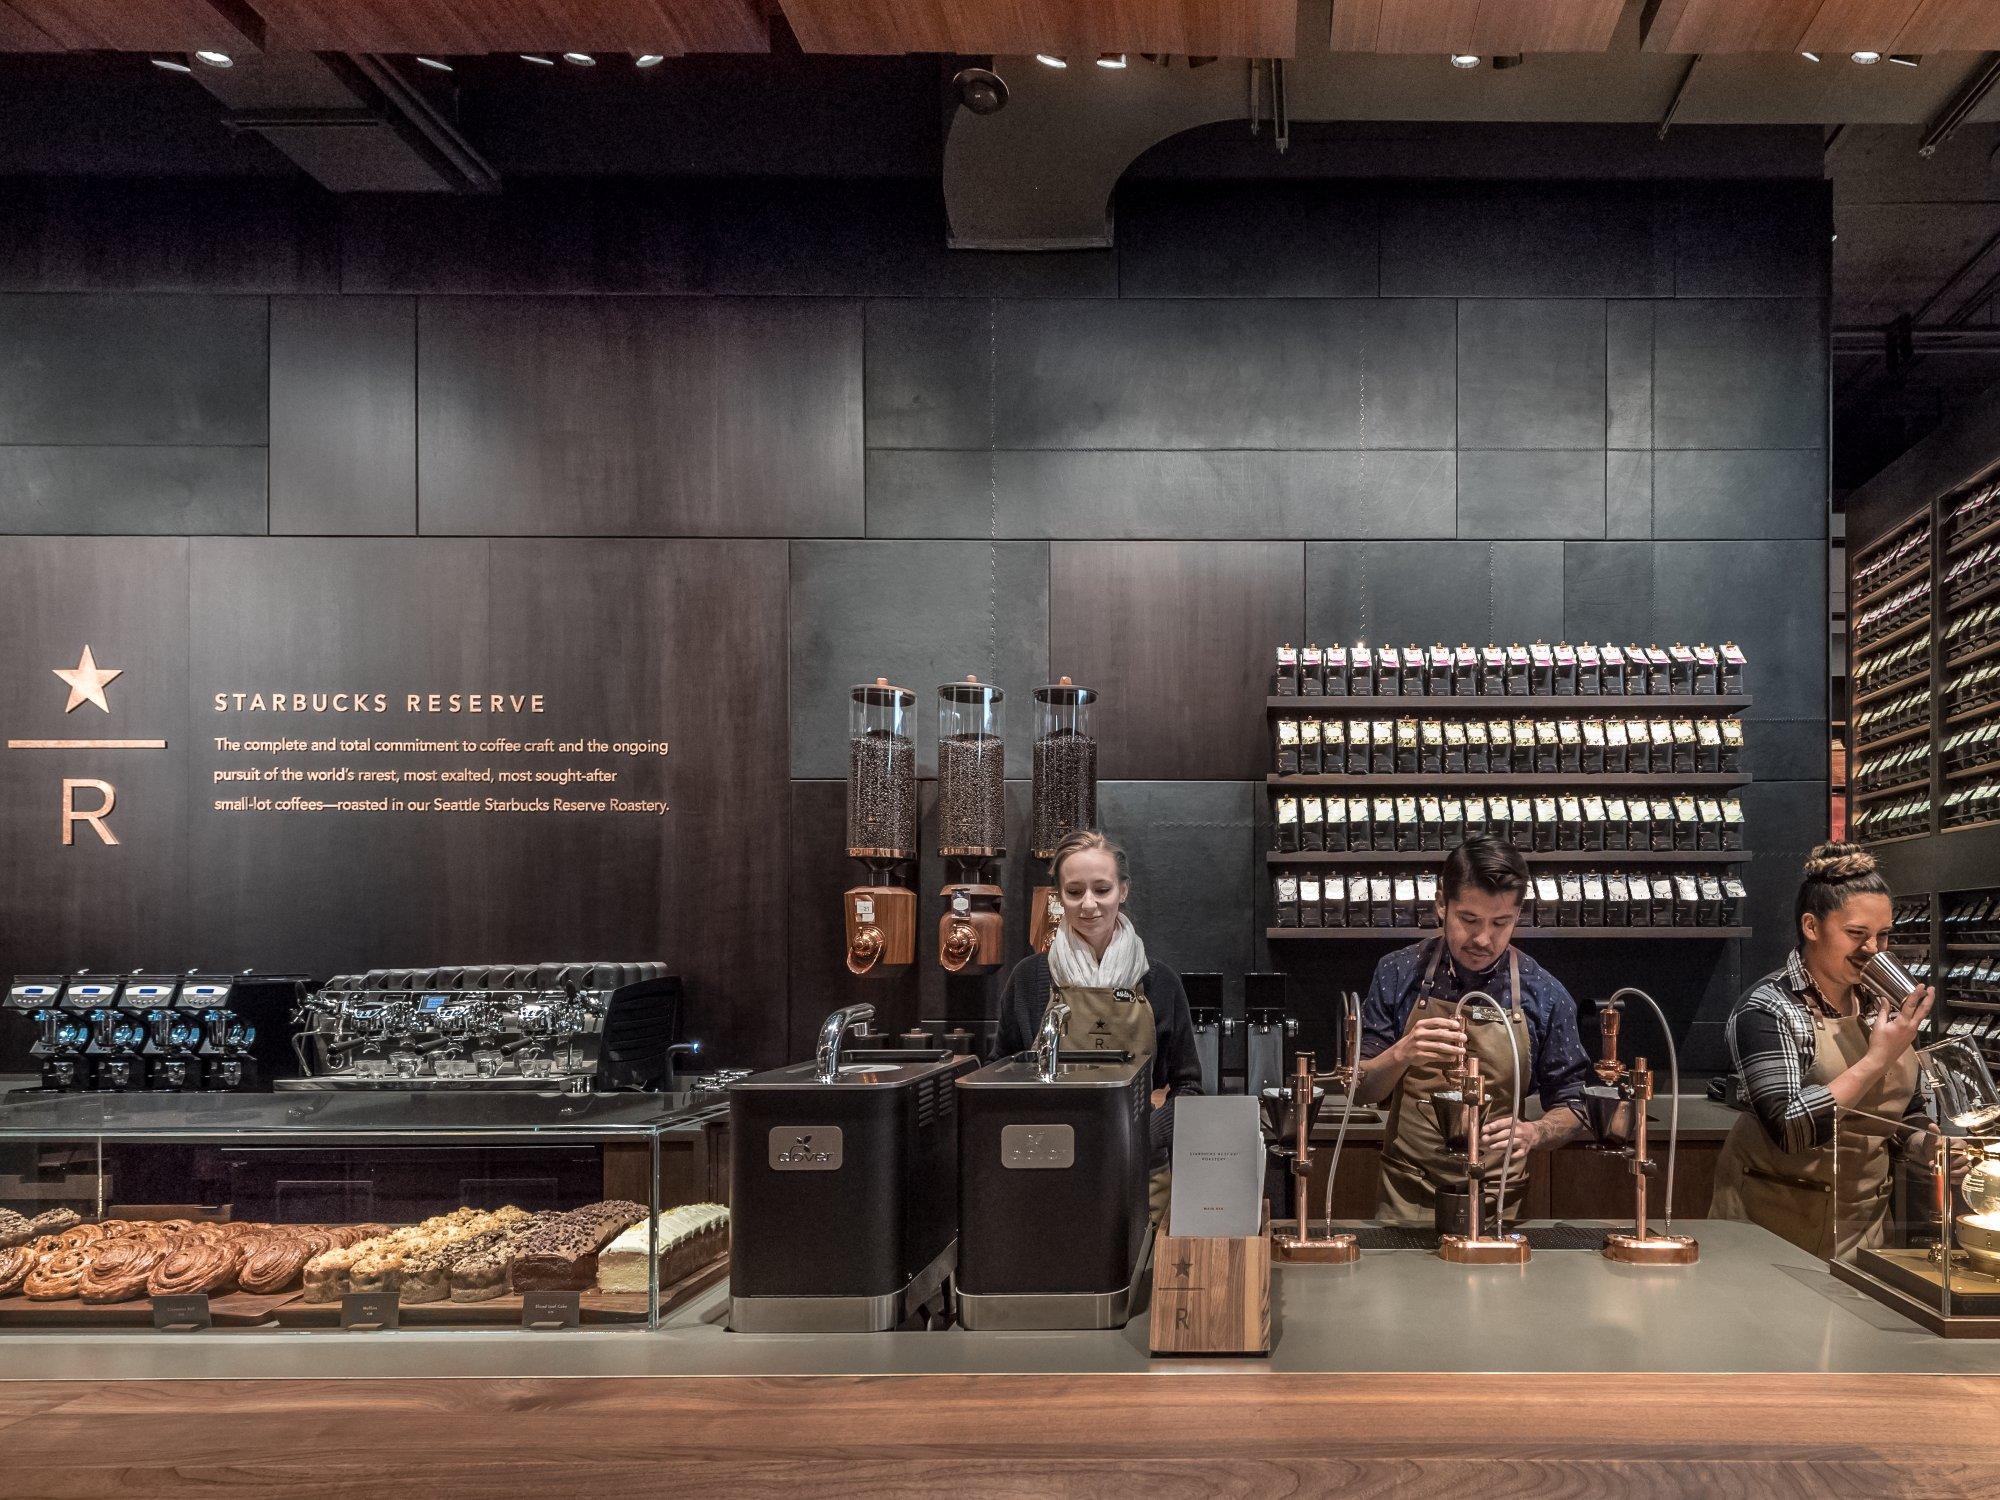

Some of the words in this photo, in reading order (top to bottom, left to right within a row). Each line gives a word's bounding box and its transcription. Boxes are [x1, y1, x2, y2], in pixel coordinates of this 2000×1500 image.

[213, 693, 388, 713] STARBUCKS
[407, 694, 545, 713] RESERVE
[213, 737, 242, 752] The
[243, 737, 308, 755] complete
[311, 737, 337, 752] and
[339, 737, 371, 752] total
[373, 738, 460, 752] commitment
[462, 740, 477, 752] to
[479, 738, 522, 752] coffee
[524, 738, 555, 752] craft
[558, 738, 584, 752] and
[587, 738, 609, 753] the
[612, 739, 669, 756] ongoing
[213, 766, 261, 784] pursuit
[263, 767, 279, 782] of
[280, 767, 304, 782] the
[306, 767, 356, 782] world's
[358, 768, 401, 784] rarest,
[403, 769, 438, 783] most
[440, 767, 496, 784] exalted,
[498, 769, 533, 783] most
[535, 767, 618, 786] sought-after
[62, 778, 120, 846] R
[213, 796, 273, 811] small-lot
[391, 797, 404, 811] in
[407, 800, 431, 812] our
[433, 797, 481, 812] Seattle
[484, 798, 550, 812] Starbucks
[553, 798, 606, 812] Reserve
[610, 799, 671, 815] Roastery.
[1095, 1038, 1105, 1050] R
[778, 1145, 835, 1162] clover
[1175, 1308, 1190, 1330] R
